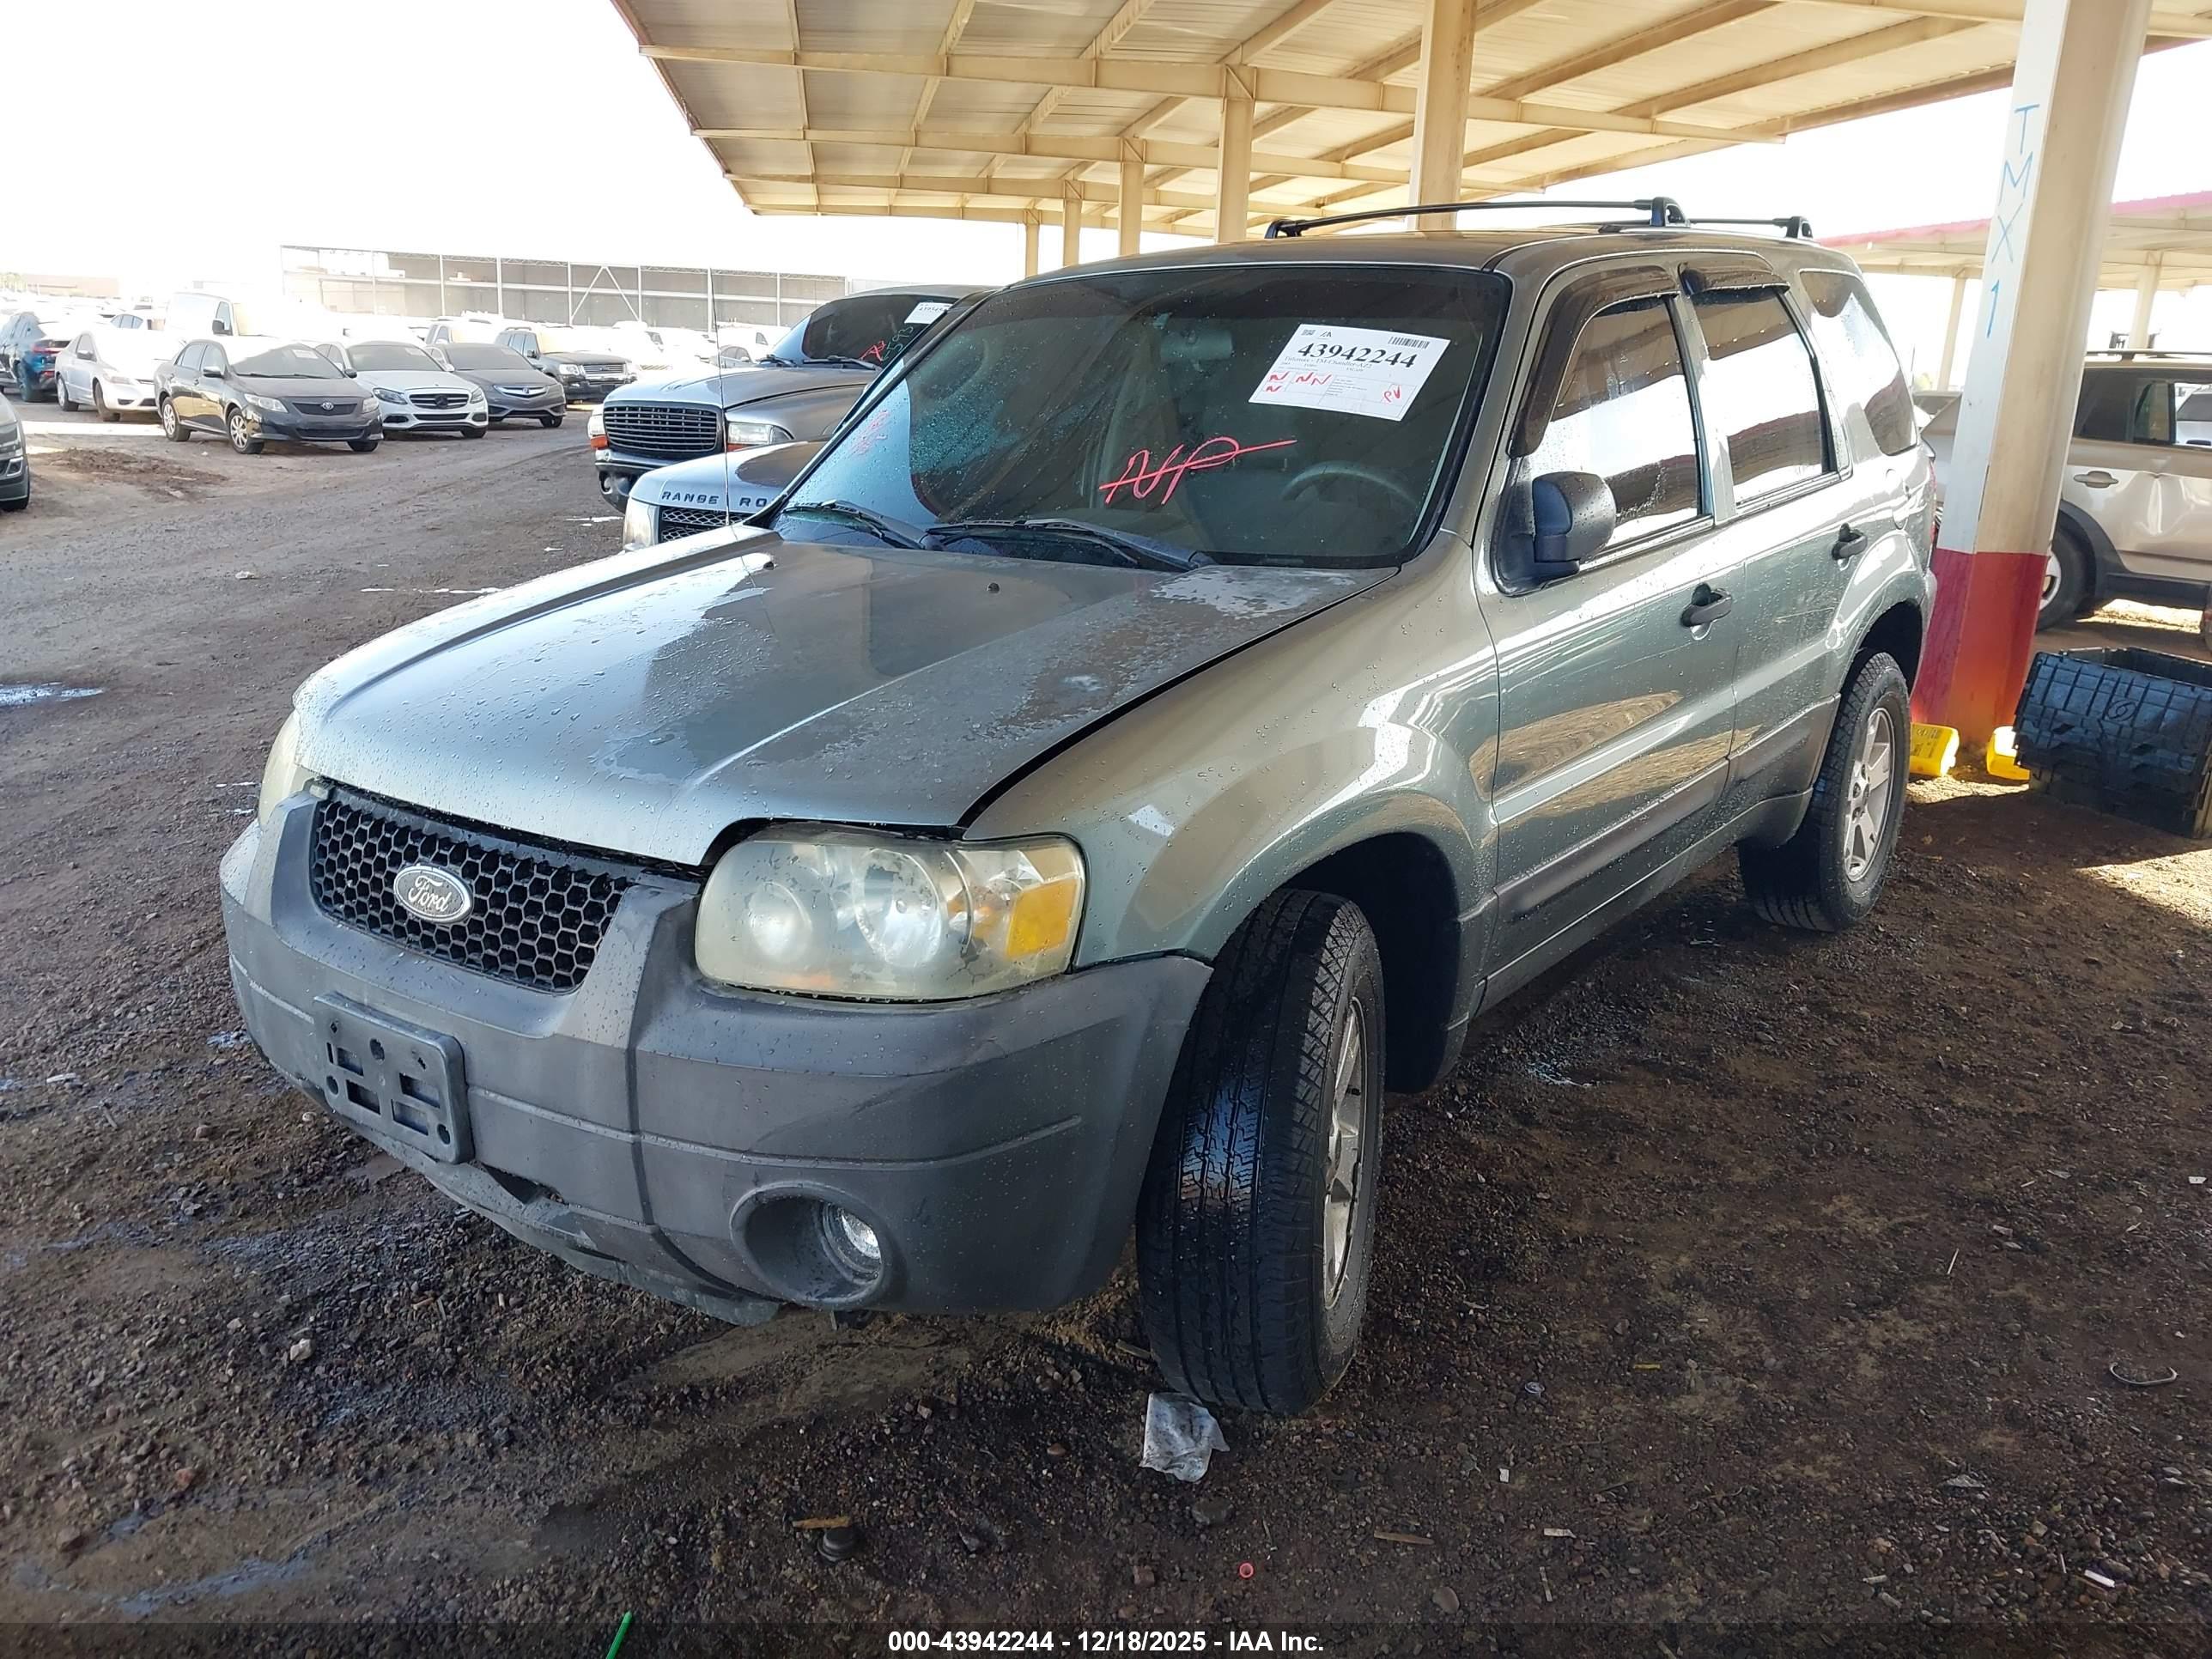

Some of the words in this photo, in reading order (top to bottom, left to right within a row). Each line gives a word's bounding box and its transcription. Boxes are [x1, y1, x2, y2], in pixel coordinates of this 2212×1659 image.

[1298, 343, 1418, 368] 43942244
[661, 490, 720, 505] RANGE
[408, 875, 452, 912] Ford
